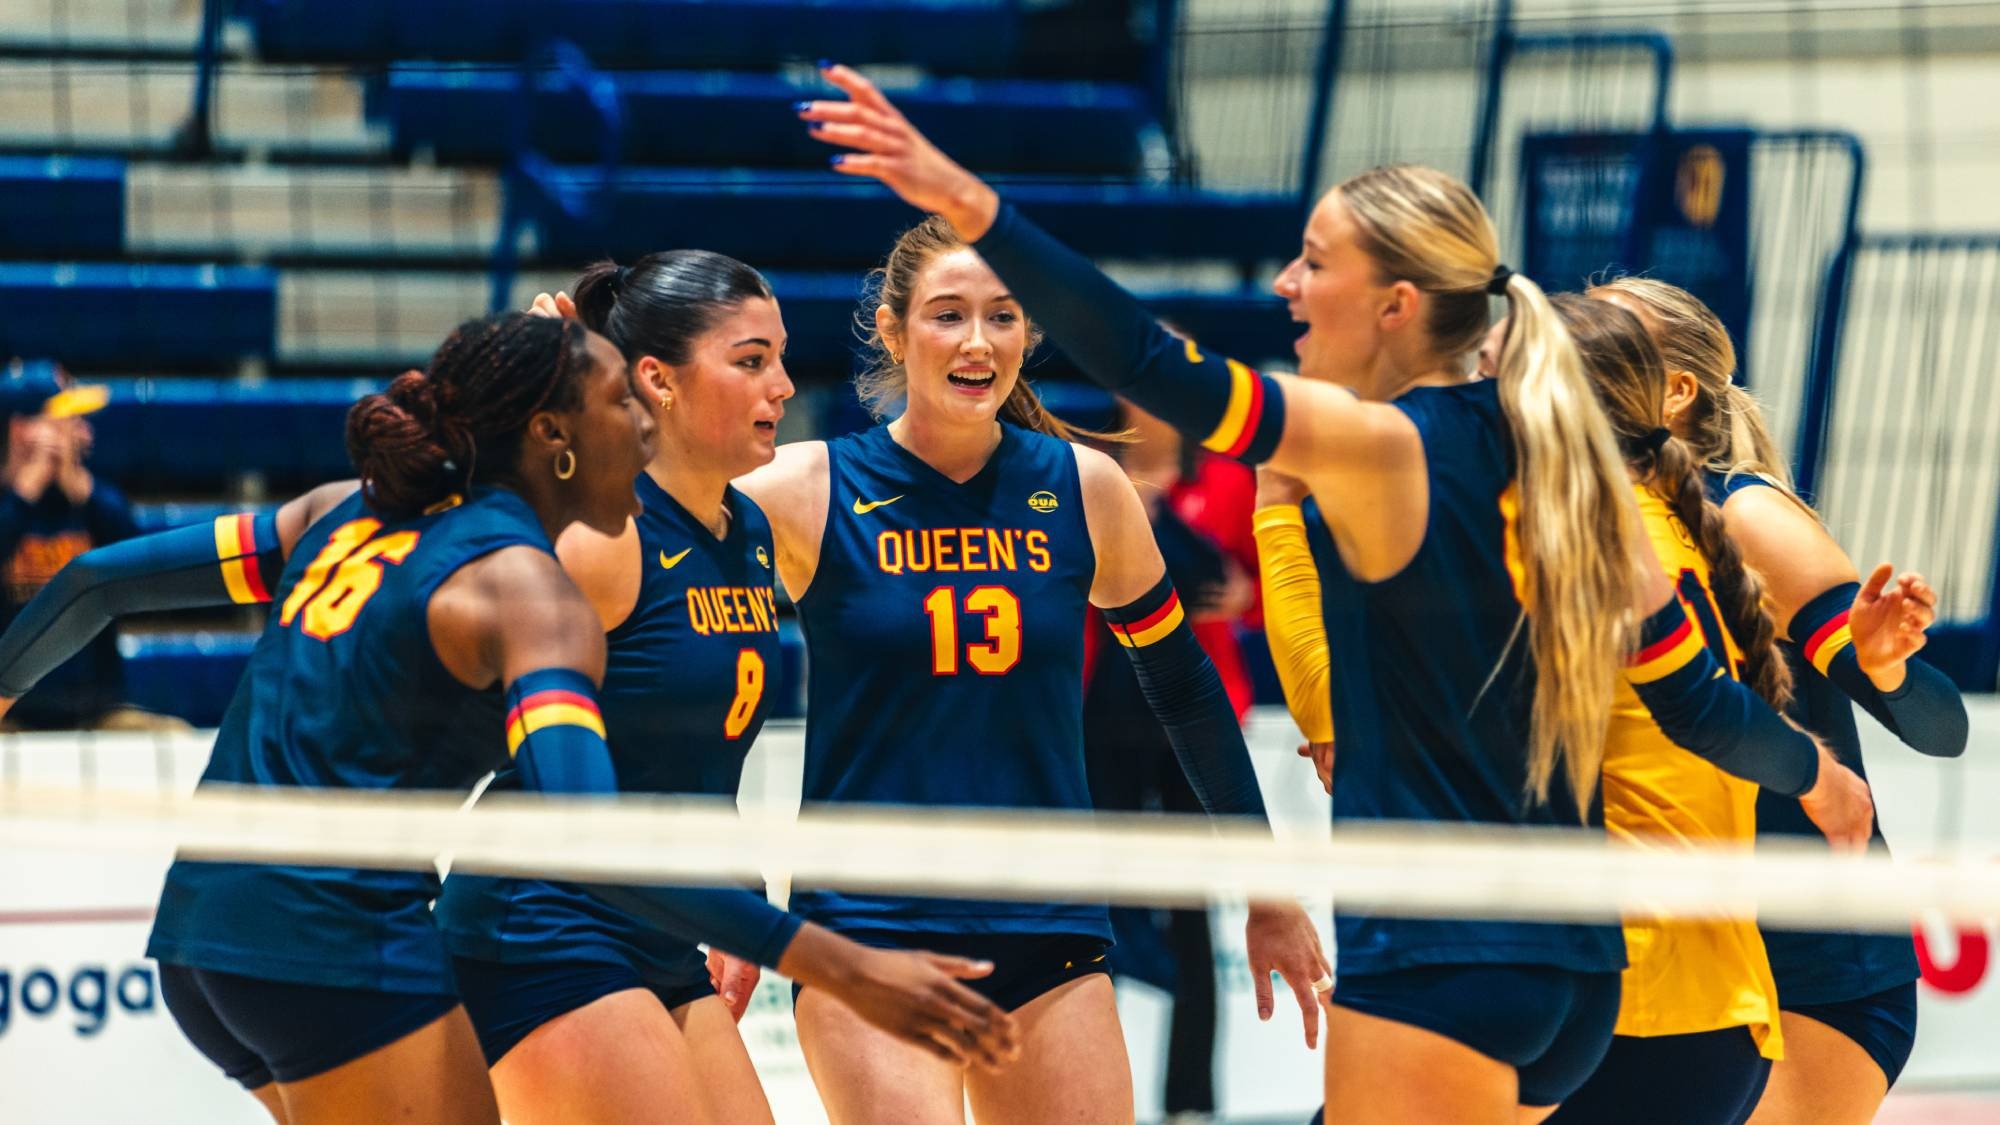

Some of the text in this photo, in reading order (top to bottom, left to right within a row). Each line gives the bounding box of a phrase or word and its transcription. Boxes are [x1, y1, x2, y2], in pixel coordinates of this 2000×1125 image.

[1028, 498, 1059, 507] OUA
[279, 517, 421, 642] 16
[878, 527, 1052, 575] QUEEN'S
[686, 586, 779, 635] QUEEN'S
[923, 584, 1023, 676] 13
[724, 647, 765, 740] 8
